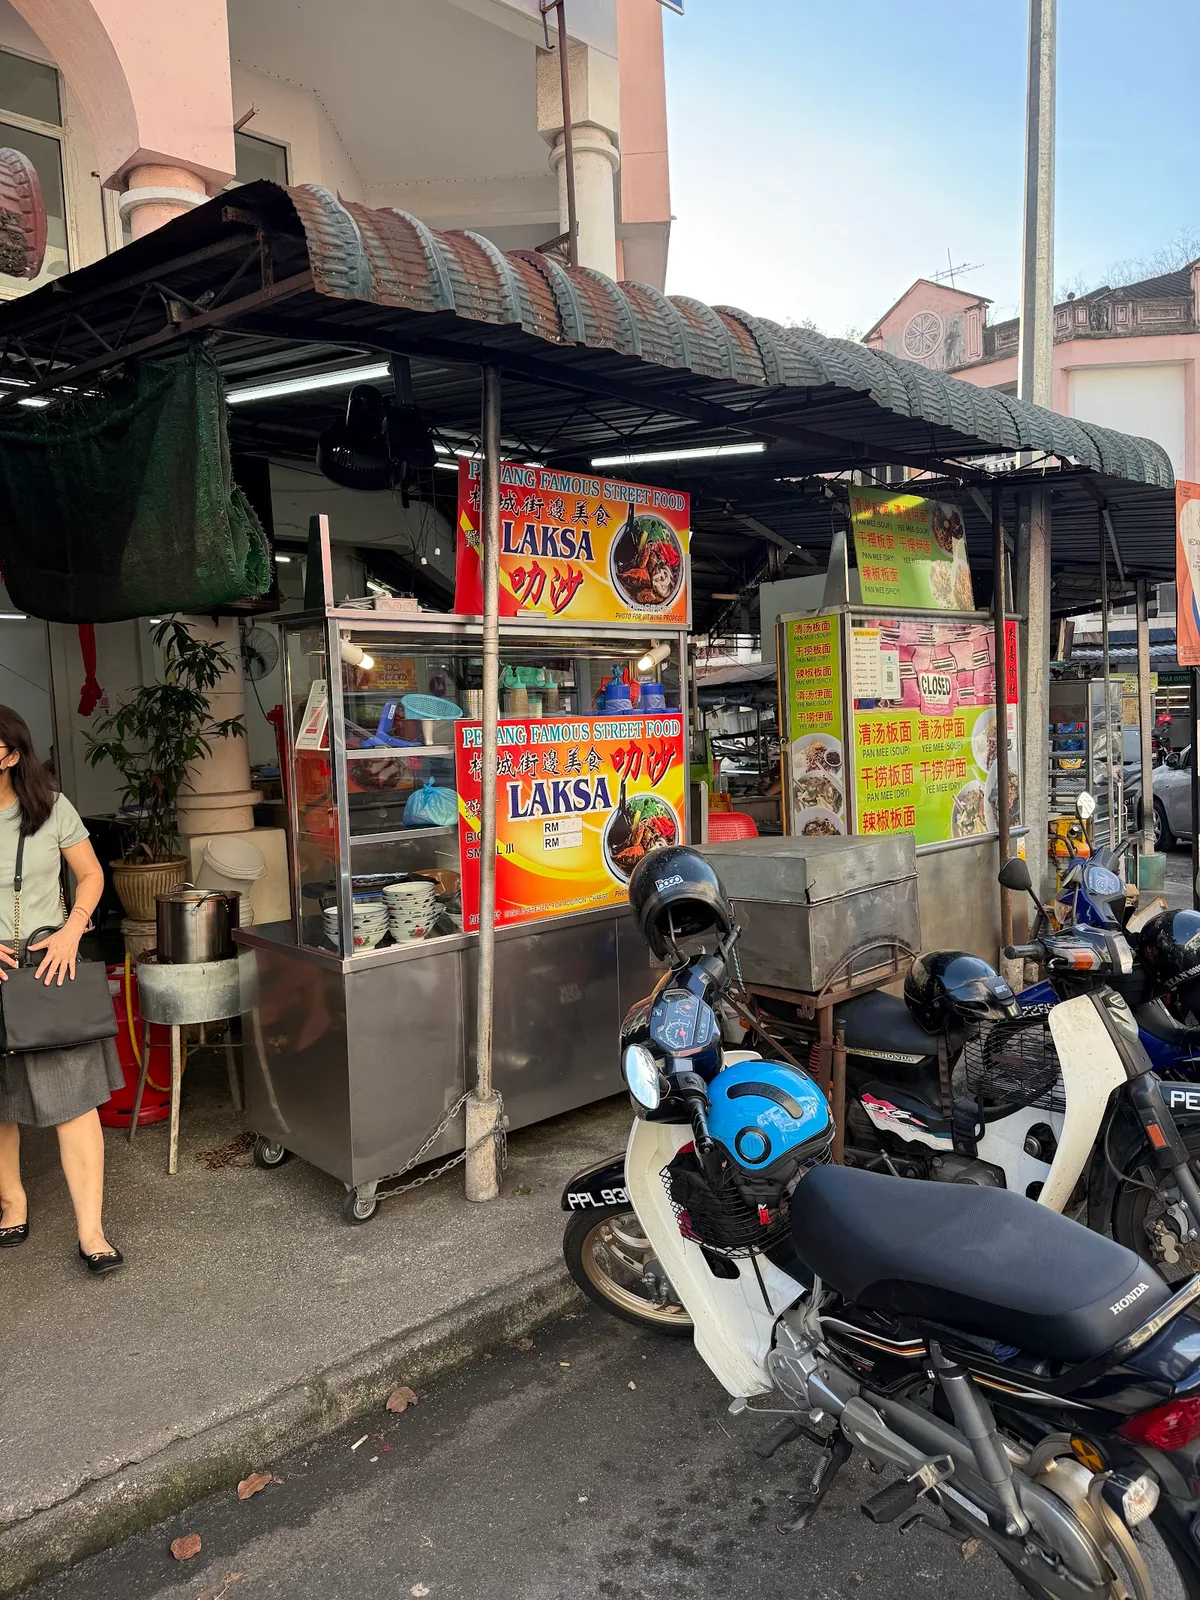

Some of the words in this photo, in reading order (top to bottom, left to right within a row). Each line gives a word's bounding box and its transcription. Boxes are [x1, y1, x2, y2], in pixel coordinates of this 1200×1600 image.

[469, 460, 536, 487] PANG
[540, 471, 600, 497] FAMOUS
[603, 482, 651, 505] STREET
[653, 490, 685, 511] FOOD
[502, 521, 594, 561] LAKSA
[508, 561, 584, 615] 叻沙
[615, 612, 632, 620] PHOTO
[632, 612, 642, 620] FOR
[642, 613, 662, 621] VIEWING
[795, 620, 831, 635] 清汤板面
[795, 643, 831, 657] 干捞板面
[795, 666, 832, 679] 辣椒板面
[797, 688, 833, 701] 清汤伊面
[921, 675, 951, 696] CLOSED
[797, 711, 833, 723] 干捞伊面
[463, 726, 527, 748] PEANG
[530, 723, 590, 745] FAMOUS
[594, 721, 643, 740] STREET
[646, 719, 680, 738] FOOD
[858, 720, 912, 746] 清汤板面
[918, 717, 965, 741] 清汤伊面
[862, 749, 875, 758] PAN
[876, 748, 889, 757] MEE
[890, 746, 911, 756] (SOUP)
[921, 743, 932, 753] YEE
[932, 742, 944, 752] MEE
[945, 740, 963, 751] (SOUP)
[610, 739, 676, 788] 叻沙
[861, 762, 914, 790] 干捞板面
[919, 757, 966, 782] 干捞伊面
[509, 777, 612, 818] LAKSA
[867, 792, 880, 802] PAN
[880, 791, 893, 801] MEE
[894, 788, 910, 799] (DRY)
[926, 785, 936, 794] YEE
[936, 784, 948, 793] MEE
[948, 781, 962, 792] (DRY)
[544, 822, 559, 833] RM
[862, 805, 915, 834] 辣椒板面
[544, 837, 560, 848] RM
[589, 892, 609, 902] CHARGE
[881, 1053, 915, 1063] HONDA
[1109, 1282, 1150, 1316] HONDA
